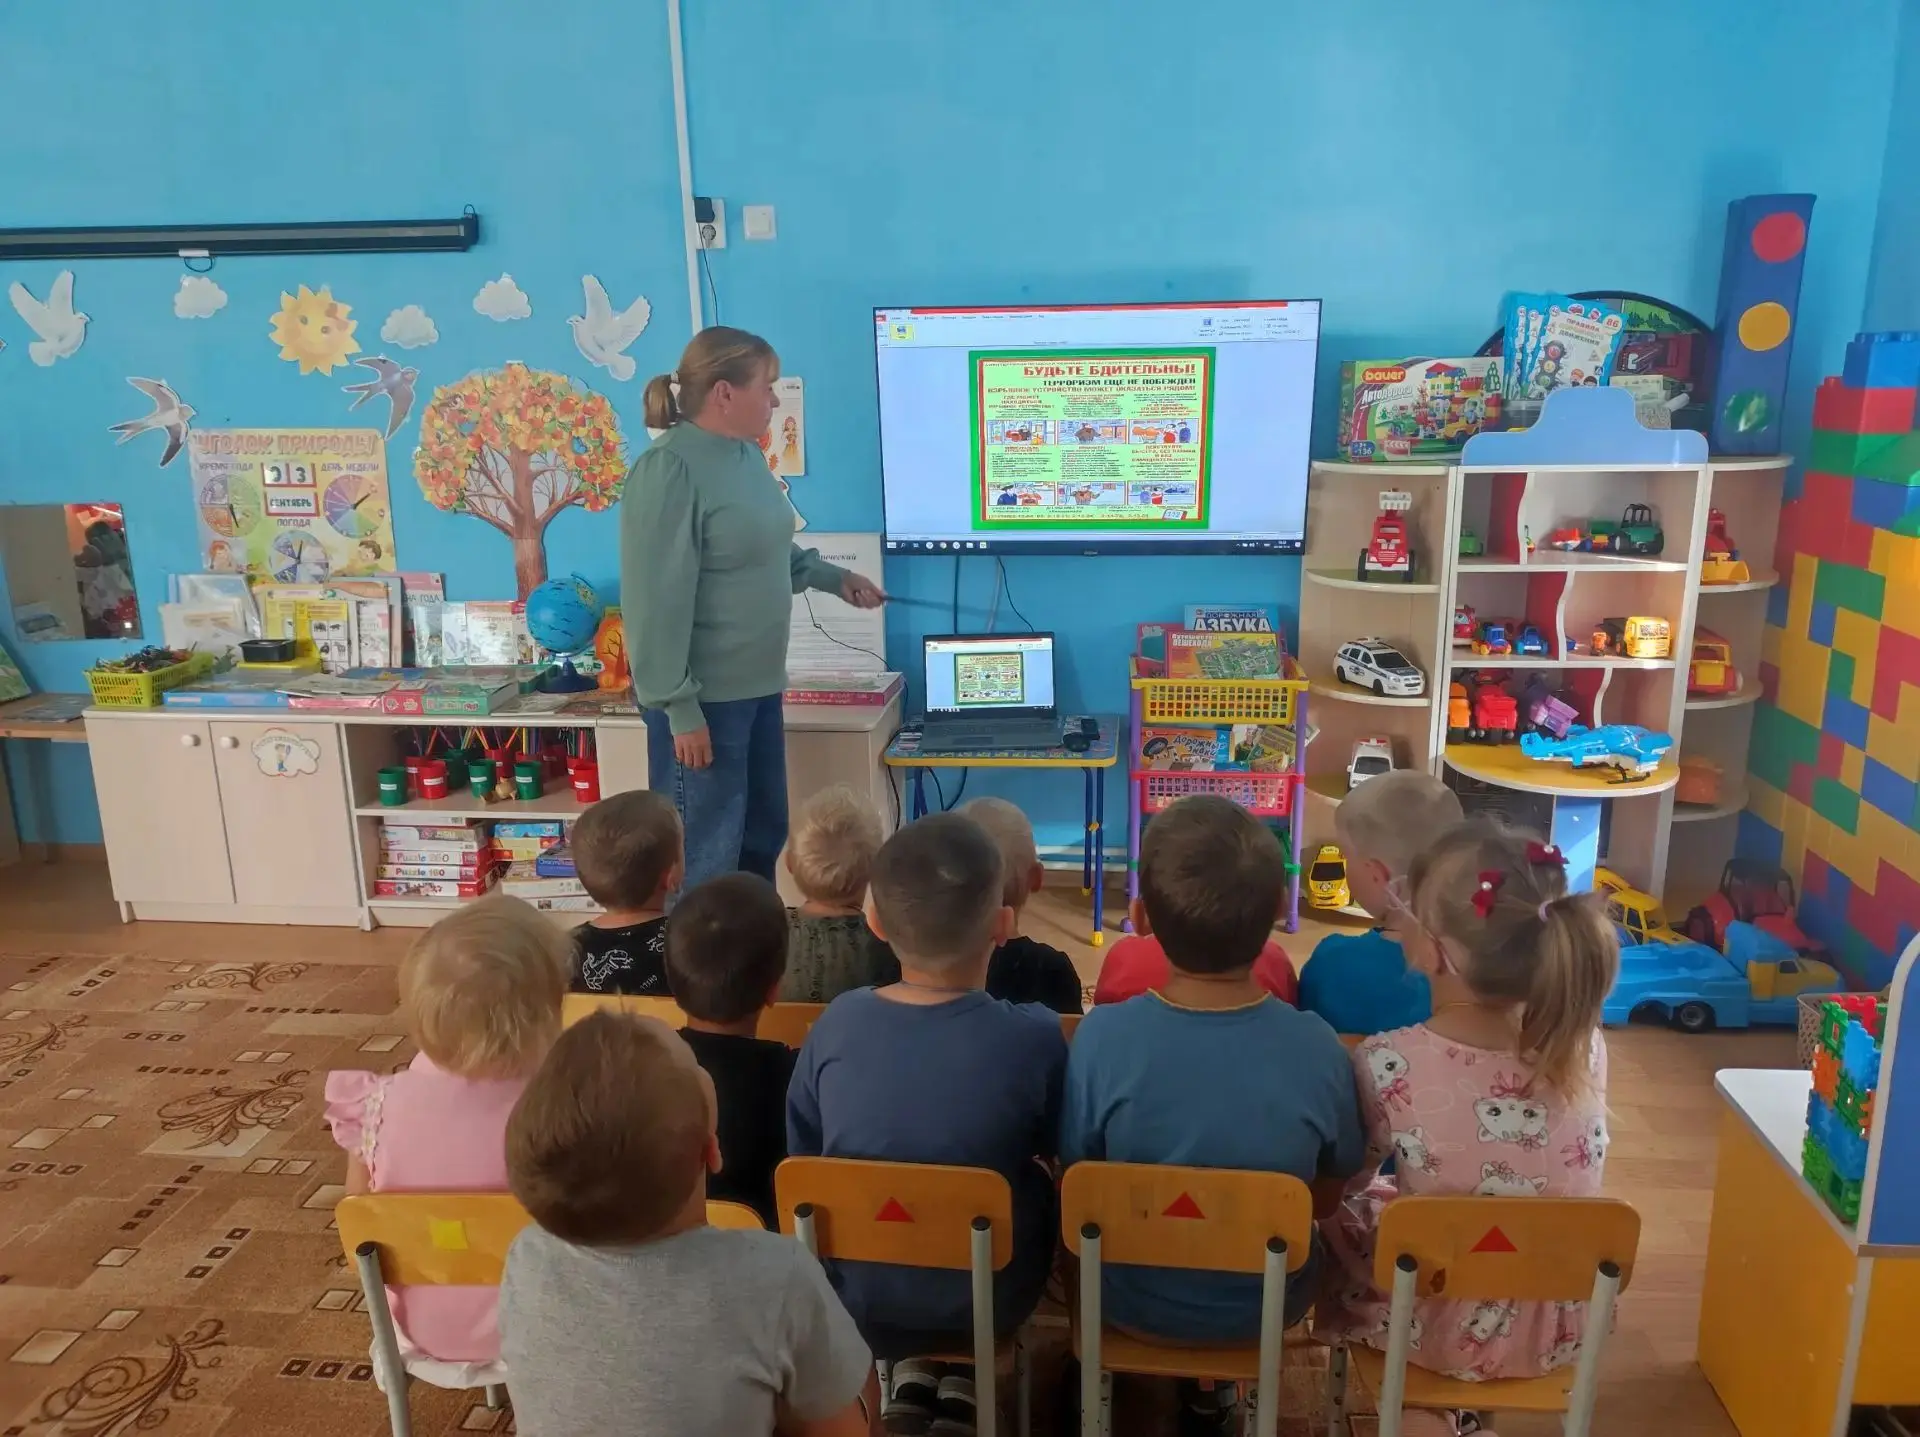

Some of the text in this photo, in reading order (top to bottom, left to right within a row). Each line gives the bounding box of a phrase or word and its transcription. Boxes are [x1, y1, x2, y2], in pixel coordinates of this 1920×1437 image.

[1606, 318, 1619, 328] 86
[1024, 364, 1196, 377] БУДЬТЕ БДИТЕЛЬНЫ!
[1364, 370, 1404, 381] bauer
[1142, 378, 1196, 386] ПОБЕЖДЕН
[277, 434, 377, 457] ПРИРОДЫ
[270, 499, 312, 507] СЕНТЯБРЬ
[277, 519, 311, 527] ПОГОДА
[1194, 618, 1272, 632] АЗБУКА
[395, 868, 426, 876] Puzzle
